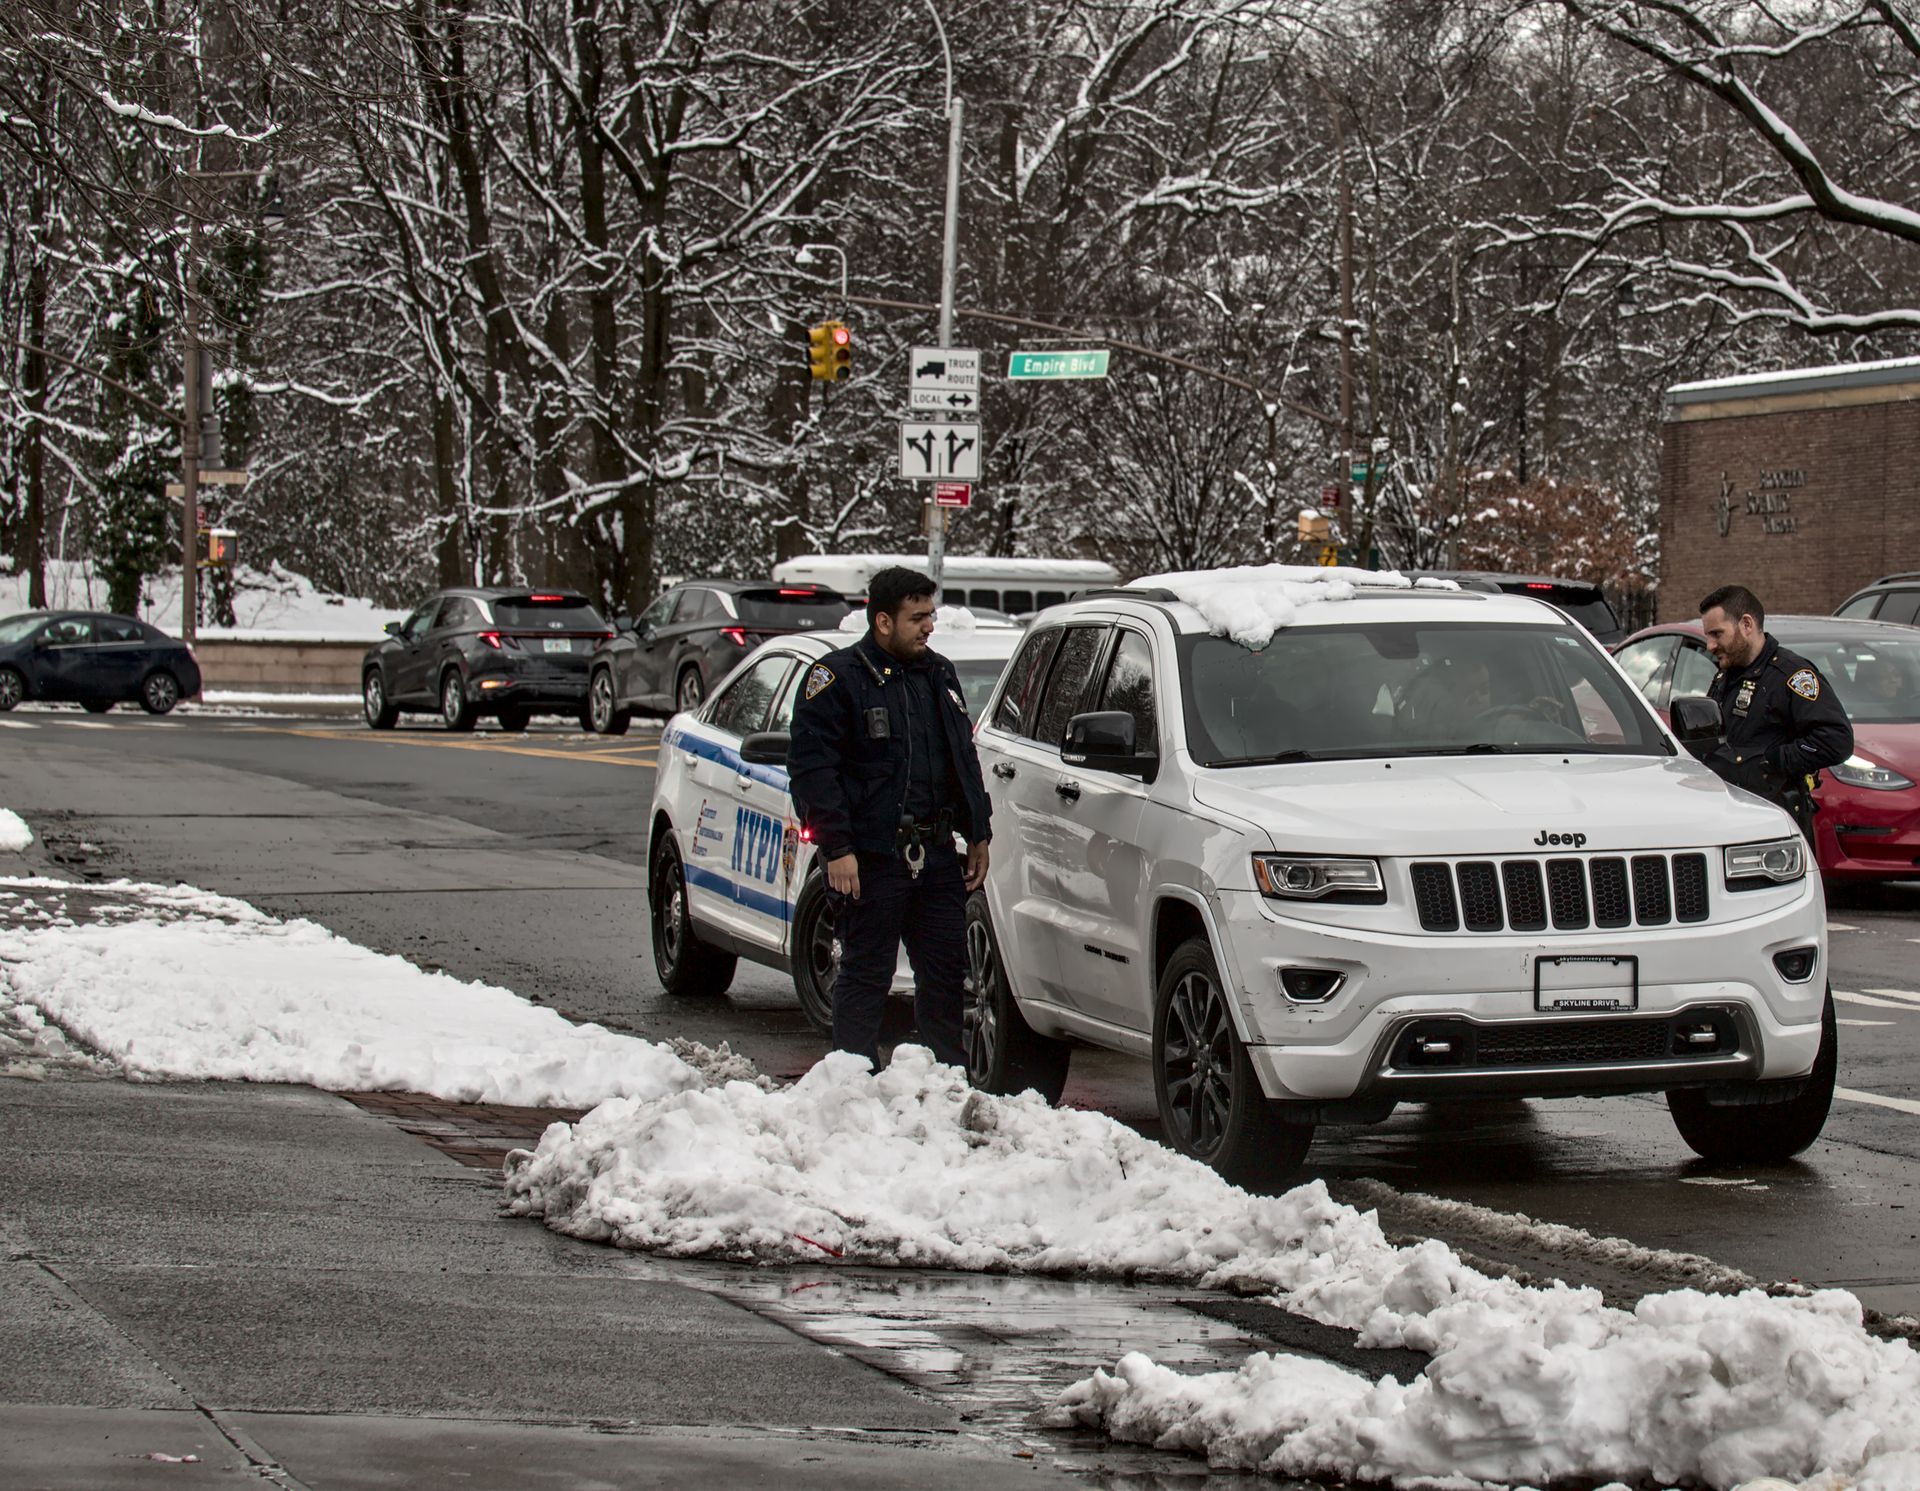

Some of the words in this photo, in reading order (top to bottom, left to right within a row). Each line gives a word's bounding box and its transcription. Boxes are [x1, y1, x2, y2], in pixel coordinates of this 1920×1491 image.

[948, 358, 976, 369] TRUCK
[1023, 358, 1066, 375] Empire
[1070, 357, 1097, 372] Blvd
[947, 374, 975, 385] ROUTE
[913, 394, 942, 405] LOCAL
[731, 805, 783, 885] NYPD
[1533, 830, 1587, 849] Jeep
